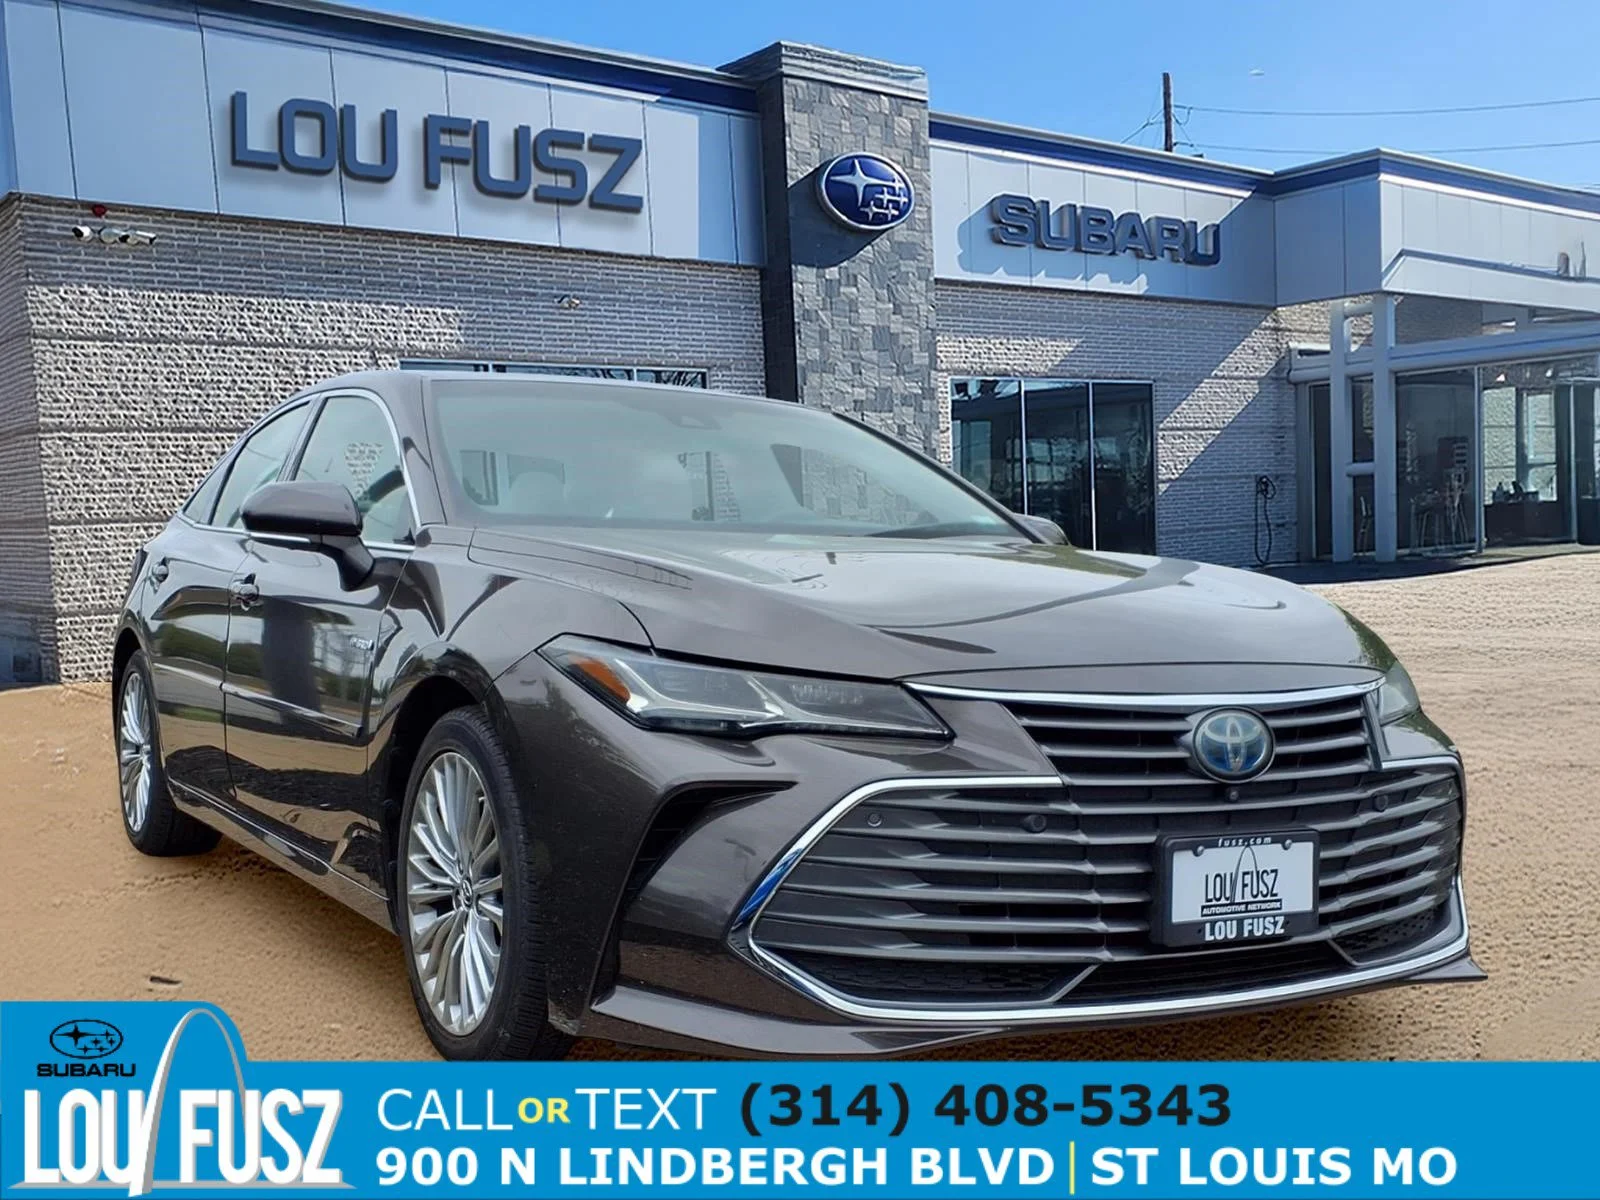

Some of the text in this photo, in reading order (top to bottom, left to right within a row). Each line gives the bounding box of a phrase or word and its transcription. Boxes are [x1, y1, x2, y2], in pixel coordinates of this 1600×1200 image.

[230, 91, 644, 213] LOU FUSZ
[990, 193, 1222, 267] SUBARU
[1218, 837, 1272, 848] fusz.com
[1205, 868, 1279, 903] LOU FUSZ
[1202, 901, 1281, 915] AUTOMOTIVE NETWORK
[1204, 915, 1285, 941] LOU FUSZ
